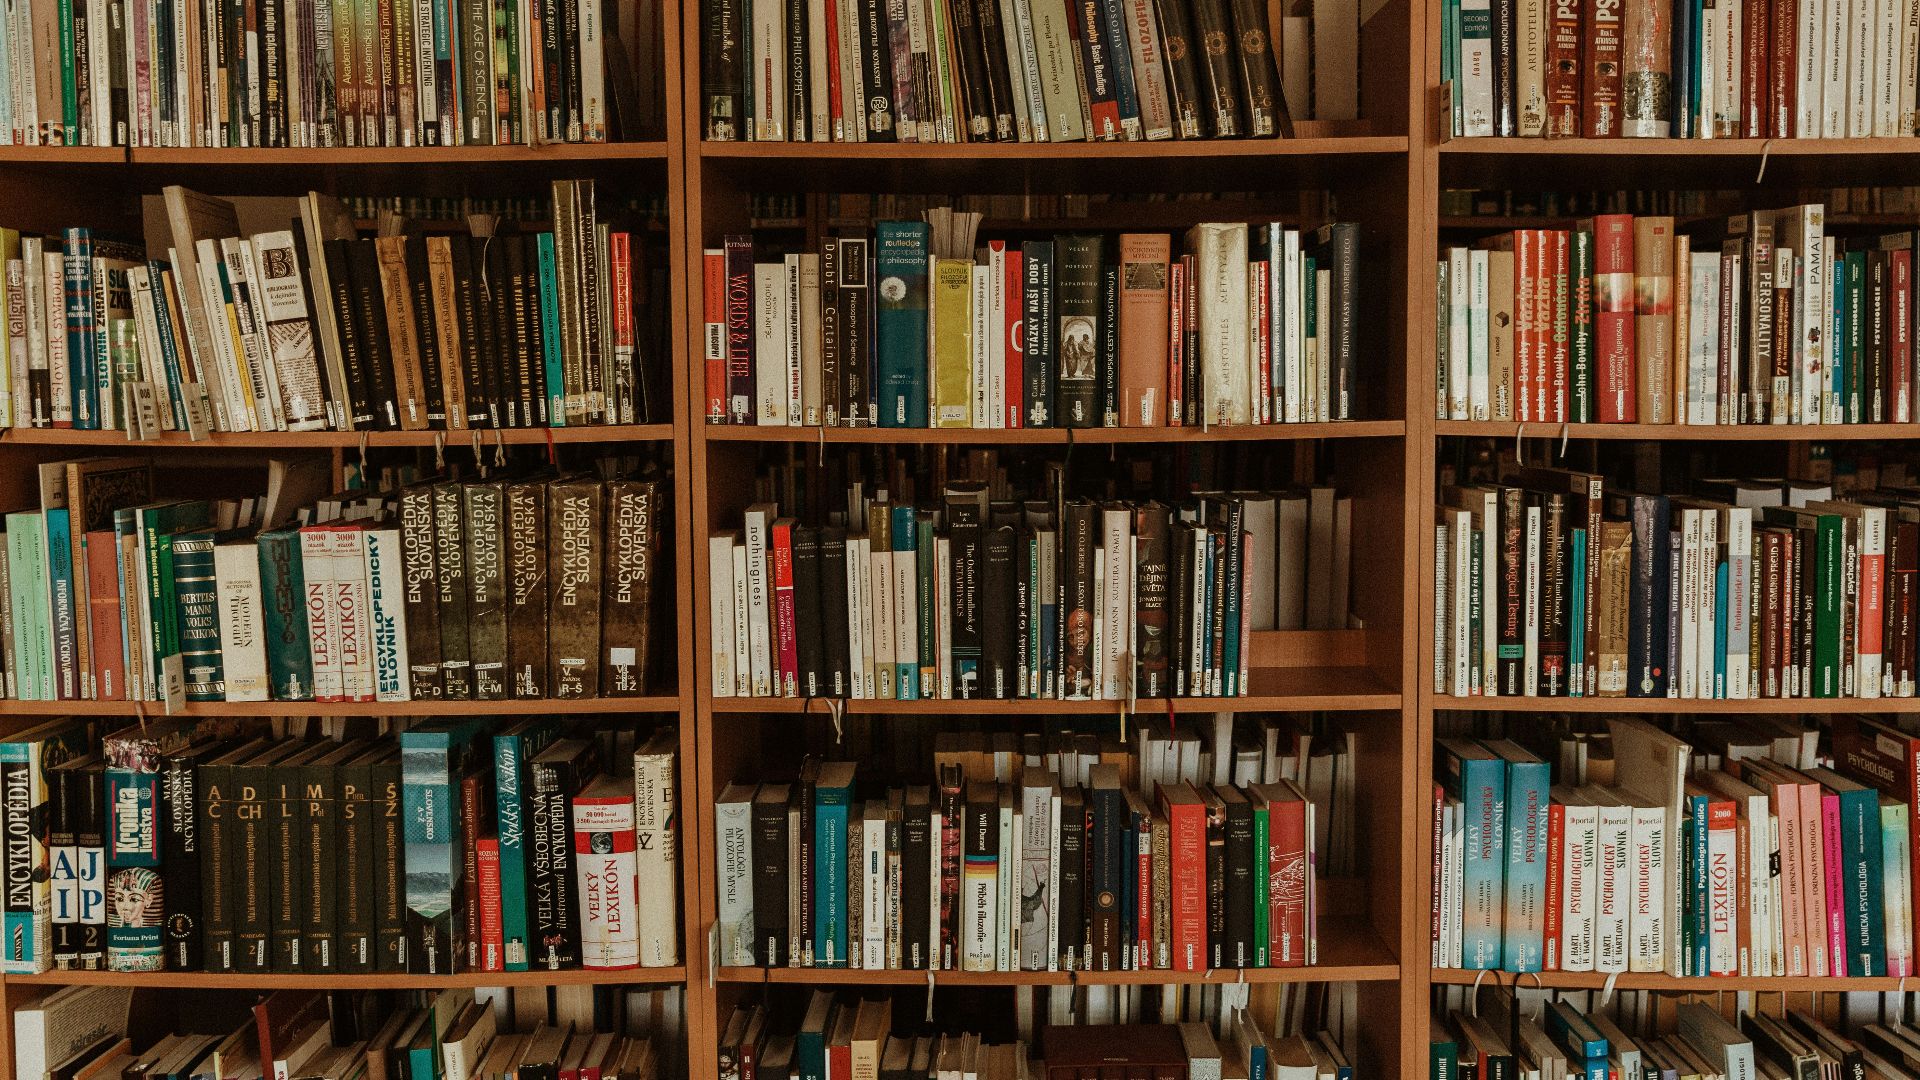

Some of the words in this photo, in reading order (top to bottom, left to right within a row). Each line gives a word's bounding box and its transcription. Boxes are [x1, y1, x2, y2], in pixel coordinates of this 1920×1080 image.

[420, 6, 431, 46] STRATEGIC
[472, 2, 483, 21] THE
[1085, 2, 1099, 43] Philosophy
[1501, 0, 1509, 56] EVOLUTIONARY
[473, 24, 484, 47] AGE
[546, 17, 556, 49] Slovník
[1023, 25, 1037, 68] NIETZSCHE
[1134, 0, 1154, 64] FILOZOFIE
[342, 28, 352, 84] Akademická
[363, 29, 374, 85] Akademická
[380, 29, 391, 86] Akademická
[421, 47, 433, 86] INVENTING
[475, 50, 484, 65] OF
[794, 36, 802, 97] PHILOSOPHY
[873, 49, 881, 87] LEKSYKON
[1048, 51, 1059, 82] Aristotela
[1092, 45, 1102, 64] Basic
[475, 69, 487, 116] SCIENCE
[1029, 70, 1042, 113] FRIEDRICH
[1053, 84, 1060, 95] Od
[1094, 65, 1107, 96] Readings
[885, 240, 920, 248] routledge
[887, 257, 926, 266] philosophy
[1343, 238, 1351, 254] ECO
[616, 266, 626, 287] Real
[825, 244, 835, 284] Doubt
[1029, 257, 1039, 284] DOBY
[1343, 256, 1351, 294] UMBERTO
[616, 289, 627, 327] Science
[729, 274, 749, 329] WORDS
[849, 292, 858, 329] Philosophy
[1026, 288, 1039, 313] NAŠÍ
[1106, 280, 1115, 321] VLASTNÍMU
[1342, 301, 1350, 327] KRÁSY
[1574, 277, 1591, 325] Ztráta
[1758, 272, 1772, 357] PERSONALITY
[710, 324, 720, 358] PHILOSOPHY
[730, 333, 749, 344] &
[823, 307, 836, 374] Certainty
[850, 338, 858, 366] Science
[1026, 317, 1039, 355] OTÁZKY
[1260, 335, 1268, 364] CAPRA
[1615, 318, 1624, 354] Personality
[1655, 322, 1663, 359] Personality
[730, 349, 749, 377] LIFE
[1105, 353, 1114, 389] EVROPSKÉ
[1518, 341, 1531, 382] Bowlby
[1609, 353, 1617, 392] Assessment
[1615, 355, 1624, 378] Theory
[1647, 356, 1656, 395] Assessment
[1776, 367, 1788, 376] 7
[147, 527, 156, 548] public
[306, 533, 326, 541] 3000
[401, 494, 421, 603] ENCYKLOPÉDIA
[416, 493, 433, 580] SLOVENSKA
[435, 493, 452, 602] ENCYKLOPÉDIA
[447, 493, 462, 578] SLOVENSKA
[966, 543, 975, 558] The
[1544, 520, 1553, 581] EVOLUTIONARY
[150, 550, 158, 577] internet
[750, 527, 762, 607] nothingness
[966, 559, 975, 585] Oxford
[1471, 557, 1479, 574] duše
[1507, 529, 1521, 597] Psychological
[1554, 551, 1564, 576] Oxford
[1770, 546, 1779, 572] FREUD
[56, 580, 71, 632] INFORMAČNÁ
[967, 586, 975, 623] Handbook
[1470, 591, 1479, 604] jako
[1554, 577, 1564, 616] Handbook
[1769, 574, 1778, 610] SIGMUND
[308, 583, 329, 666] LEXIKÓN
[337, 582, 358, 666] LEXIKÓN
[367, 534, 388, 693] ENCYKLOPEDICKÝ
[1111, 606, 1119, 645] ASSMANN
[1471, 606, 1479, 619] Sny
[1506, 600, 1520, 637] Testing
[1544, 585, 1552, 639] PSYCHOLOGY
[162, 770, 171, 800] MALÁ
[116, 787, 139, 853] Kronika
[426, 789, 434, 839] SLOVENSKO
[978, 813, 987, 827] Will
[1697, 803, 1706, 826] řidiče
[529, 793, 550, 878] VŠEOBECNÁ
[726, 828, 735, 873] FILOZOFIE
[736, 827, 747, 879] ANTOLÓGIA
[978, 828, 987, 851] Durant
[1468, 824, 1479, 861] VELKÝ
[1785, 819, 1795, 862] PSYCHOLÓGIA
[1697, 842, 1707, 889] Psychologie
[554, 874, 567, 929] ilustrovaná
[727, 875, 736, 904] MYSLE
[977, 883, 987, 909] Příběh
[1698, 892, 1706, 914] Havlík
[976, 910, 987, 943] filozofie
[1571, 933, 1580, 956] HARTL
[1581, 917, 1591, 954] HARTLOVÁ
[1614, 919, 1623, 955] HARTLOVÁ
[1859, 913, 1869, 946] KLINICKÁ
[1603, 934, 1612, 957] HARTL
